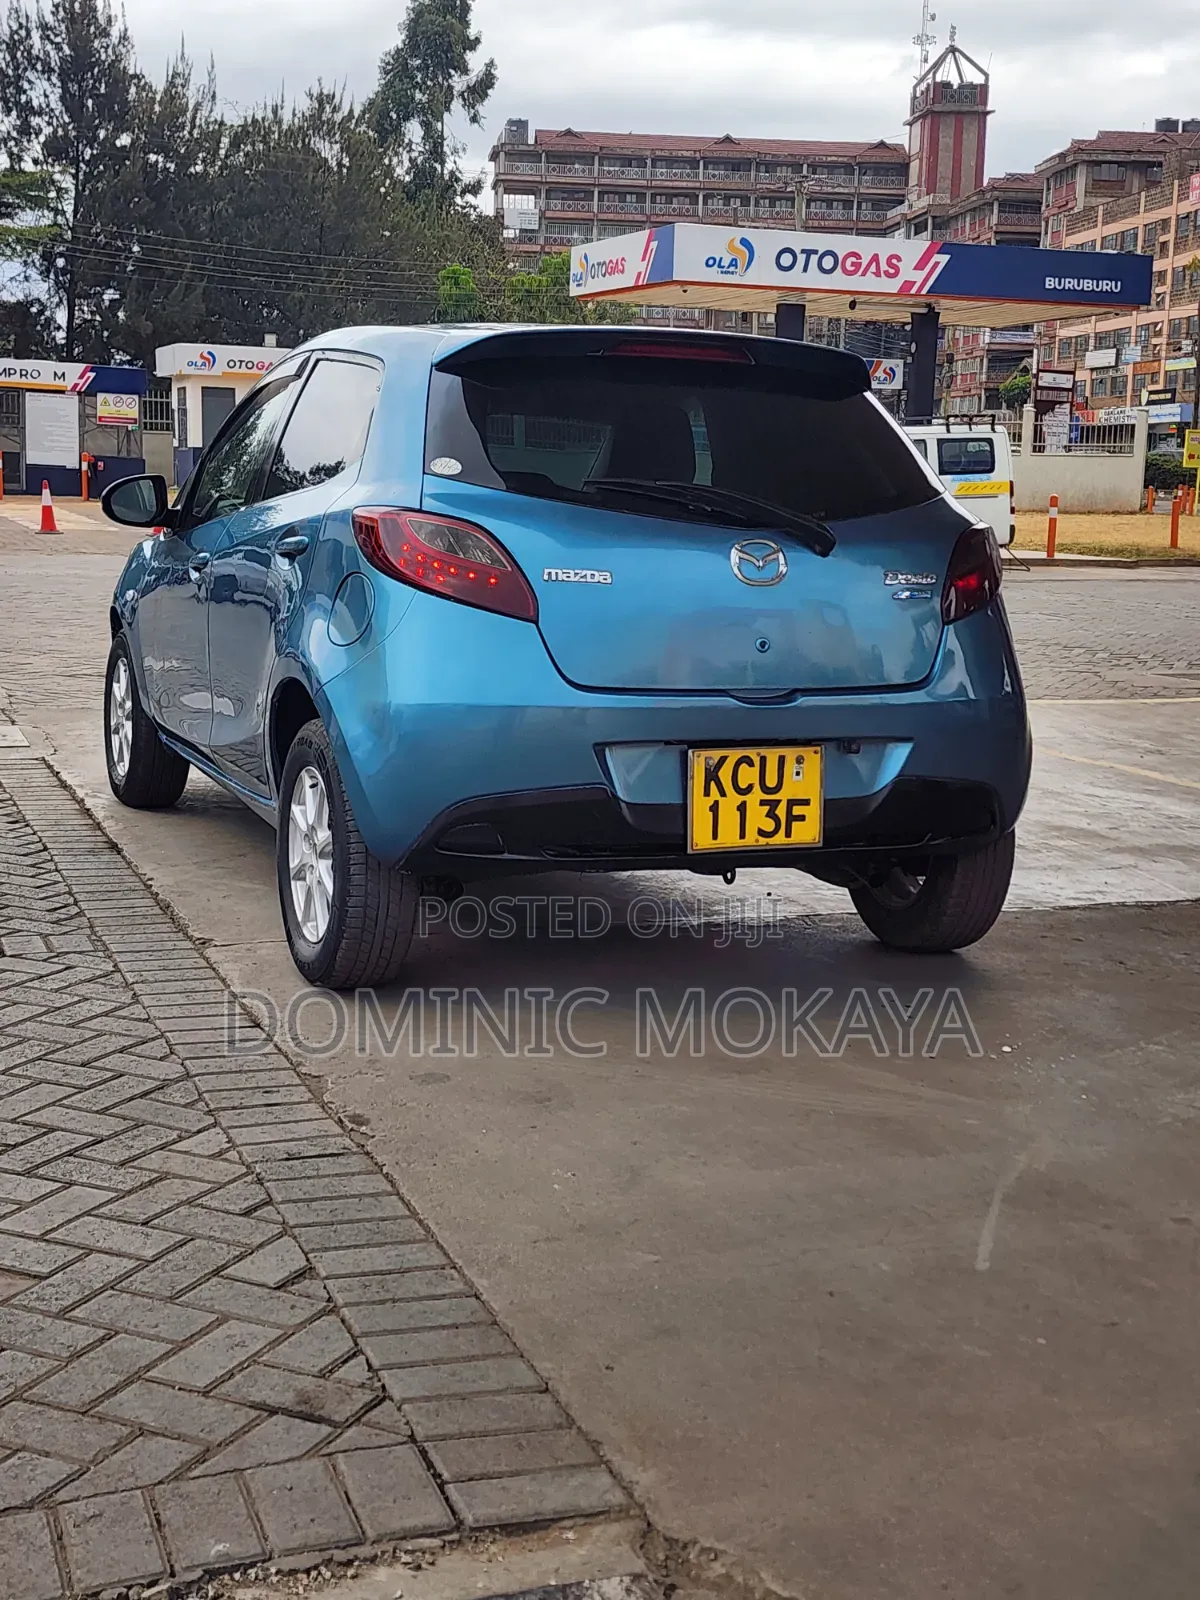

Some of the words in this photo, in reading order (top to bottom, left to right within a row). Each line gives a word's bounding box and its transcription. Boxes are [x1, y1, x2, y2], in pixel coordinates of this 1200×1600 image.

[590, 256, 626, 280] OTOGAS
[704, 256, 739, 270] OLA
[775, 246, 902, 279] OTOGAS
[571, 271, 583, 283] OLA
[1045, 276, 1121, 292] BURUBURU
[1098, 415, 1131, 424] CHEMIST
[703, 754, 786, 797] KCU
[709, 798, 811, 841] 113F
